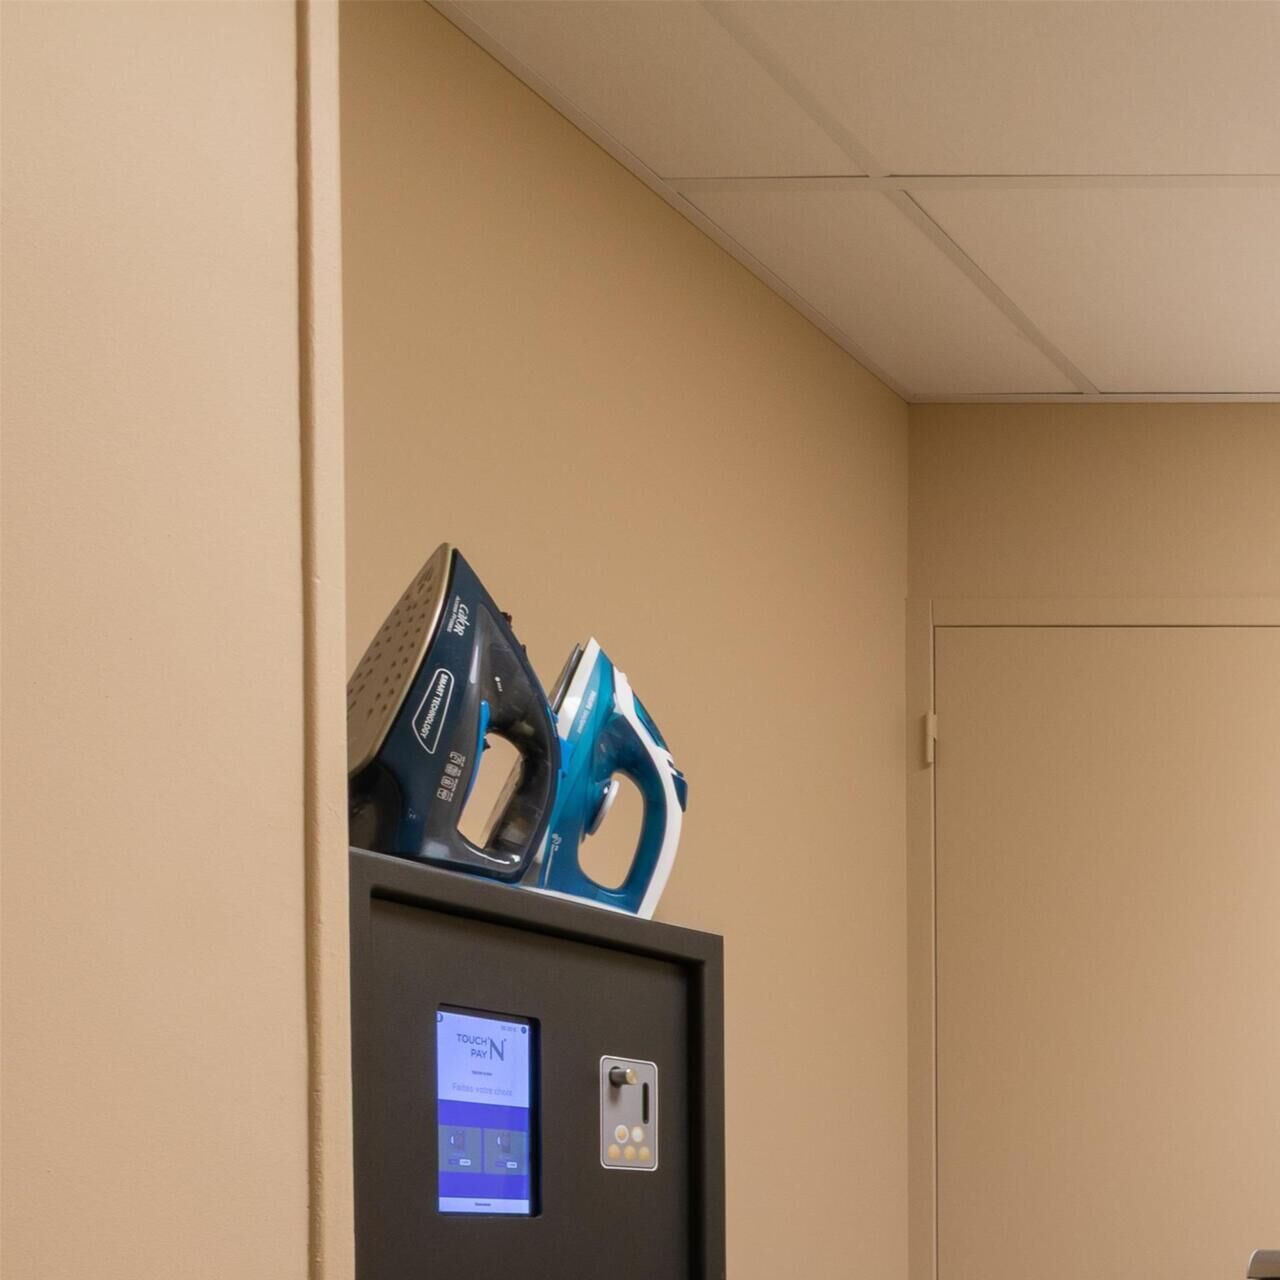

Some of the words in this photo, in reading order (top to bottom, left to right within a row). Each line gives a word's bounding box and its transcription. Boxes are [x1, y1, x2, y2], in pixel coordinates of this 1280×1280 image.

[436, 673, 450, 697] SMART
[420, 697, 442, 738] TECHNOLOGY
[471, 1048, 488, 1059] PAY
